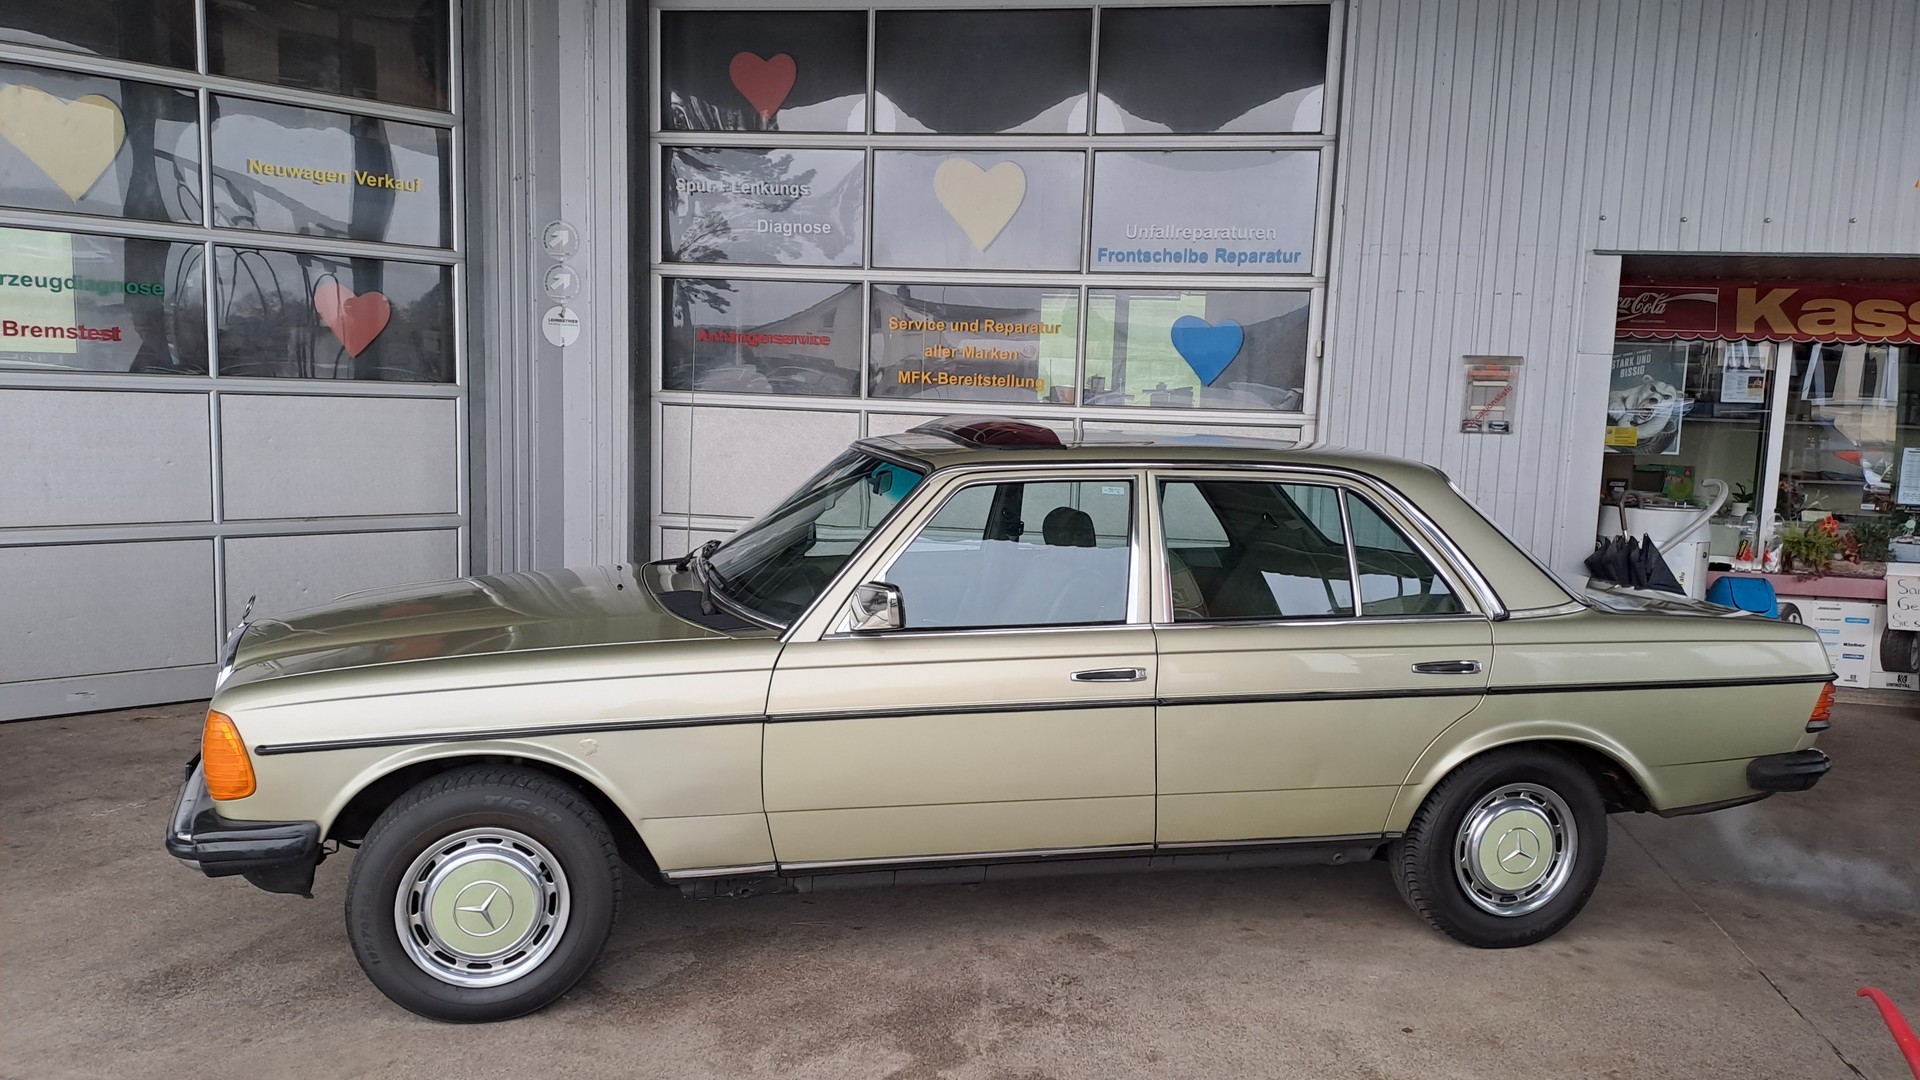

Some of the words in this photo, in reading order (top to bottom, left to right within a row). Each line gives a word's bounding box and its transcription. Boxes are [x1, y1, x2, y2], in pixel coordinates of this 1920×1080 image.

[249, 159, 349, 185] Neuwagen
[355, 170, 423, 192] Verkauf
[757, 219, 832, 236] Diagnose
[1125, 223, 1277, 241] Unfallreparaturen
[1215, 248, 1302, 266] Reparatur
[1737, 287, 1920, 337] Kas
[2, 320, 122, 341] Bremstest
[889, 317, 945, 332] Service
[950, 319, 979, 333] und
[984, 319, 1061, 336] Reparatur
[697, 328, 831, 347] Anhängerservice
[924, 344, 957, 358] aller
[962, 346, 1019, 360] Marken
[1612, 355, 1634, 369] STARK
[1636, 354, 1652, 365] UND
[1620, 365, 1645, 378] BISSIG
[898, 371, 1045, 391] MFK-Bereitstellung
